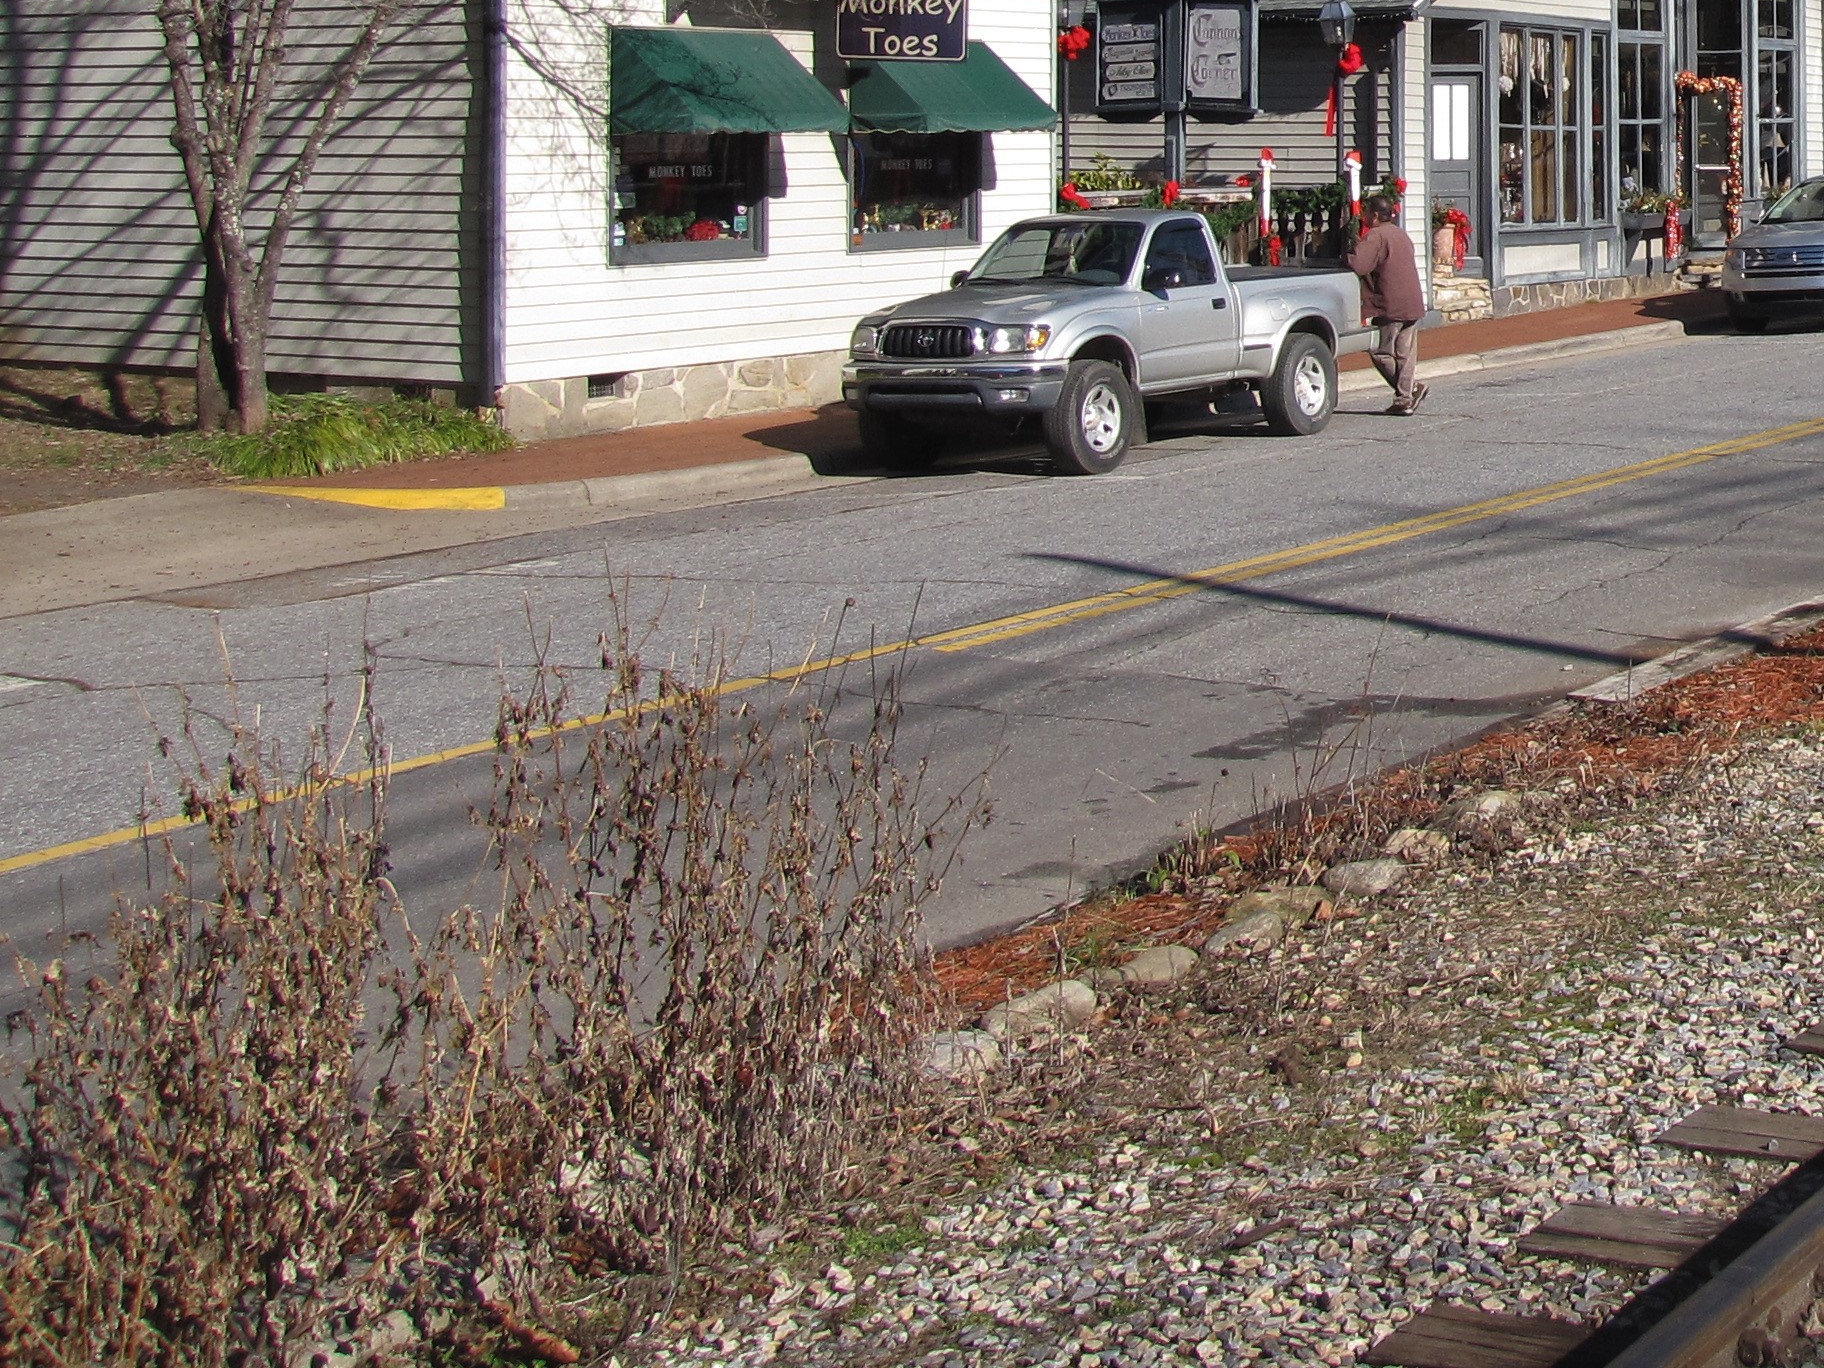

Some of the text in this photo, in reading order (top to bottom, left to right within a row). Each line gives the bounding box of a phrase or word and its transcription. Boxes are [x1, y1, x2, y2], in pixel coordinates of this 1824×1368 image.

[861, 27, 938, 56] Toes
[1191, 54, 1236, 88] Corner
[649, 164, 713, 178] MONKEY TOES
[881, 158, 933, 170] MONKEY TOES
